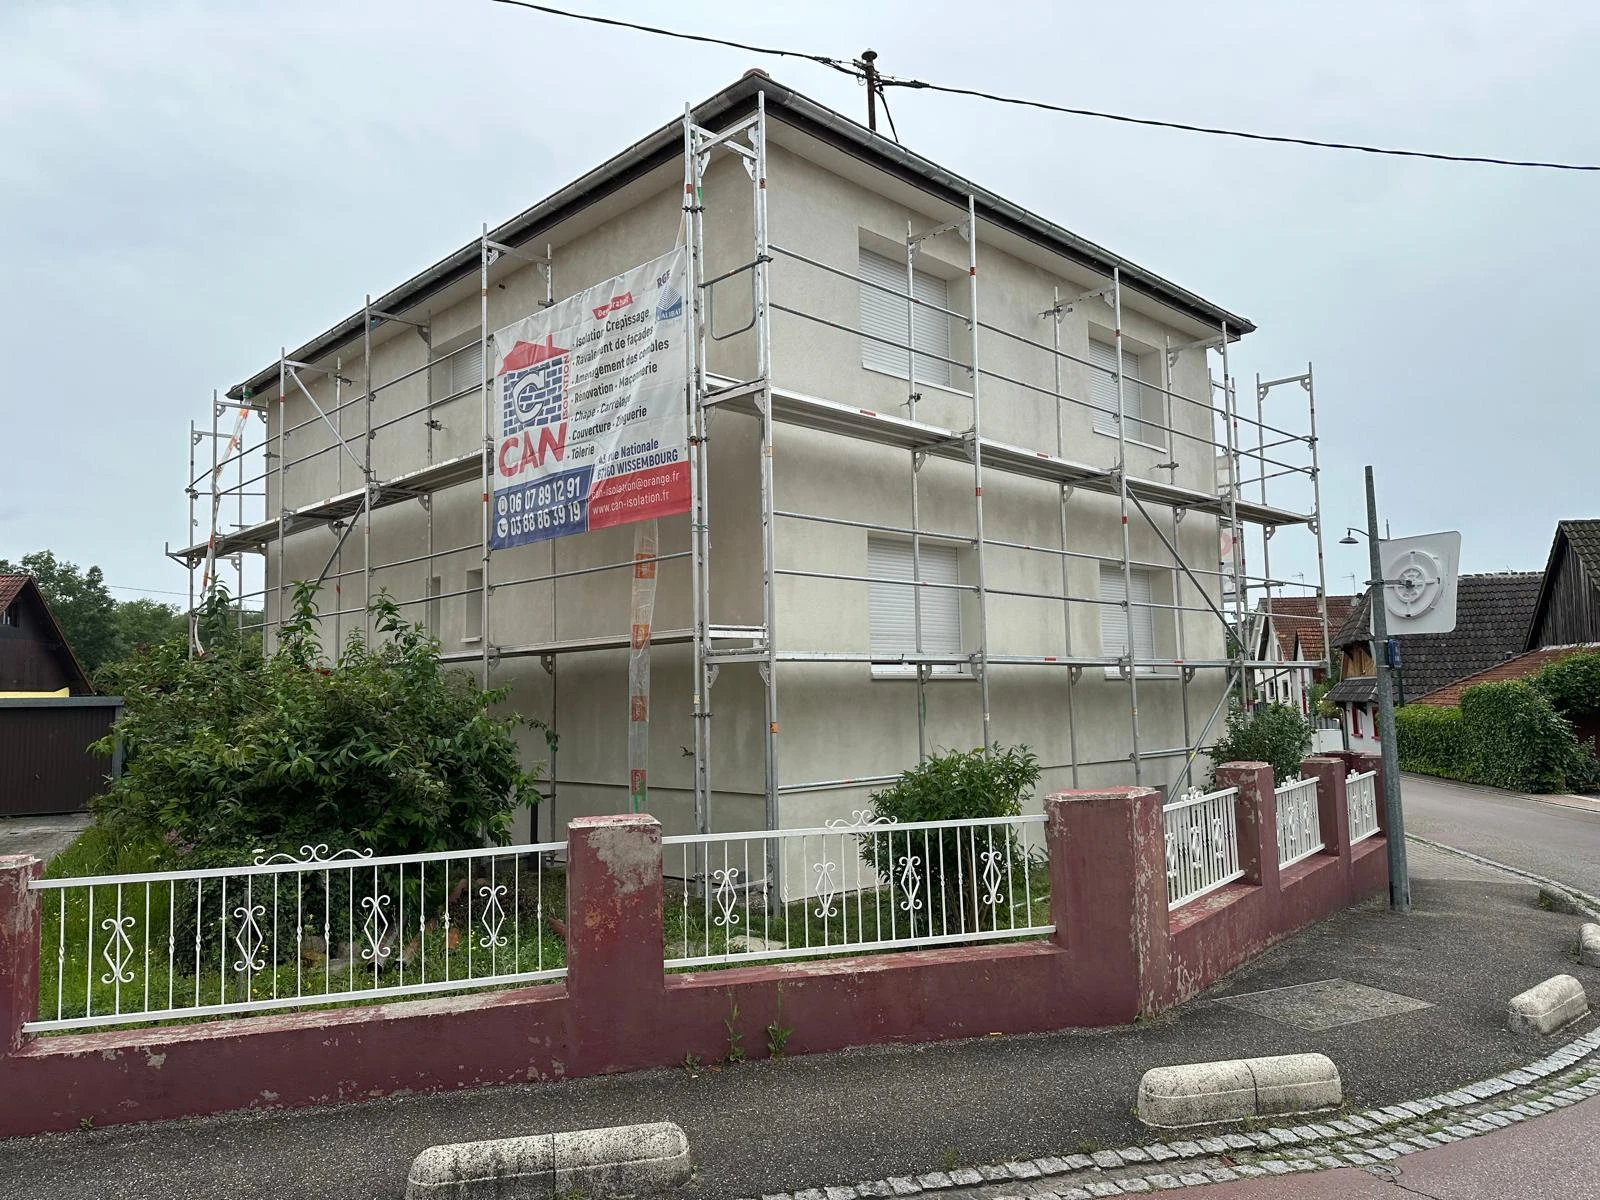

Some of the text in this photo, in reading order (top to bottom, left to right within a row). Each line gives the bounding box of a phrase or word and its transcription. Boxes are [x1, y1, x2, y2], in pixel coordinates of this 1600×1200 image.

[606, 308, 649, 332] Crépissage
[576, 326, 653, 366] Ravaleent de façades
[626, 353, 637, 366] des
[572, 422, 611, 441] Couverture
[615, 405, 647, 428] Zguerie
[574, 408, 595, 423] Chape
[498, 422, 567, 477] CAN
[607, 450, 619, 462] rue
[621, 438, 659, 457] Nationale
[616, 448, 678, 474] WISSEMBOURG
[509, 476, 580, 514] 06 07 89 12 91
[591, 470, 679, 500] can-isolation@orange.fr
[592, 490, 669, 514] www.can-isolation.fr
[510, 501, 580, 536] 03 88 86 39 19
